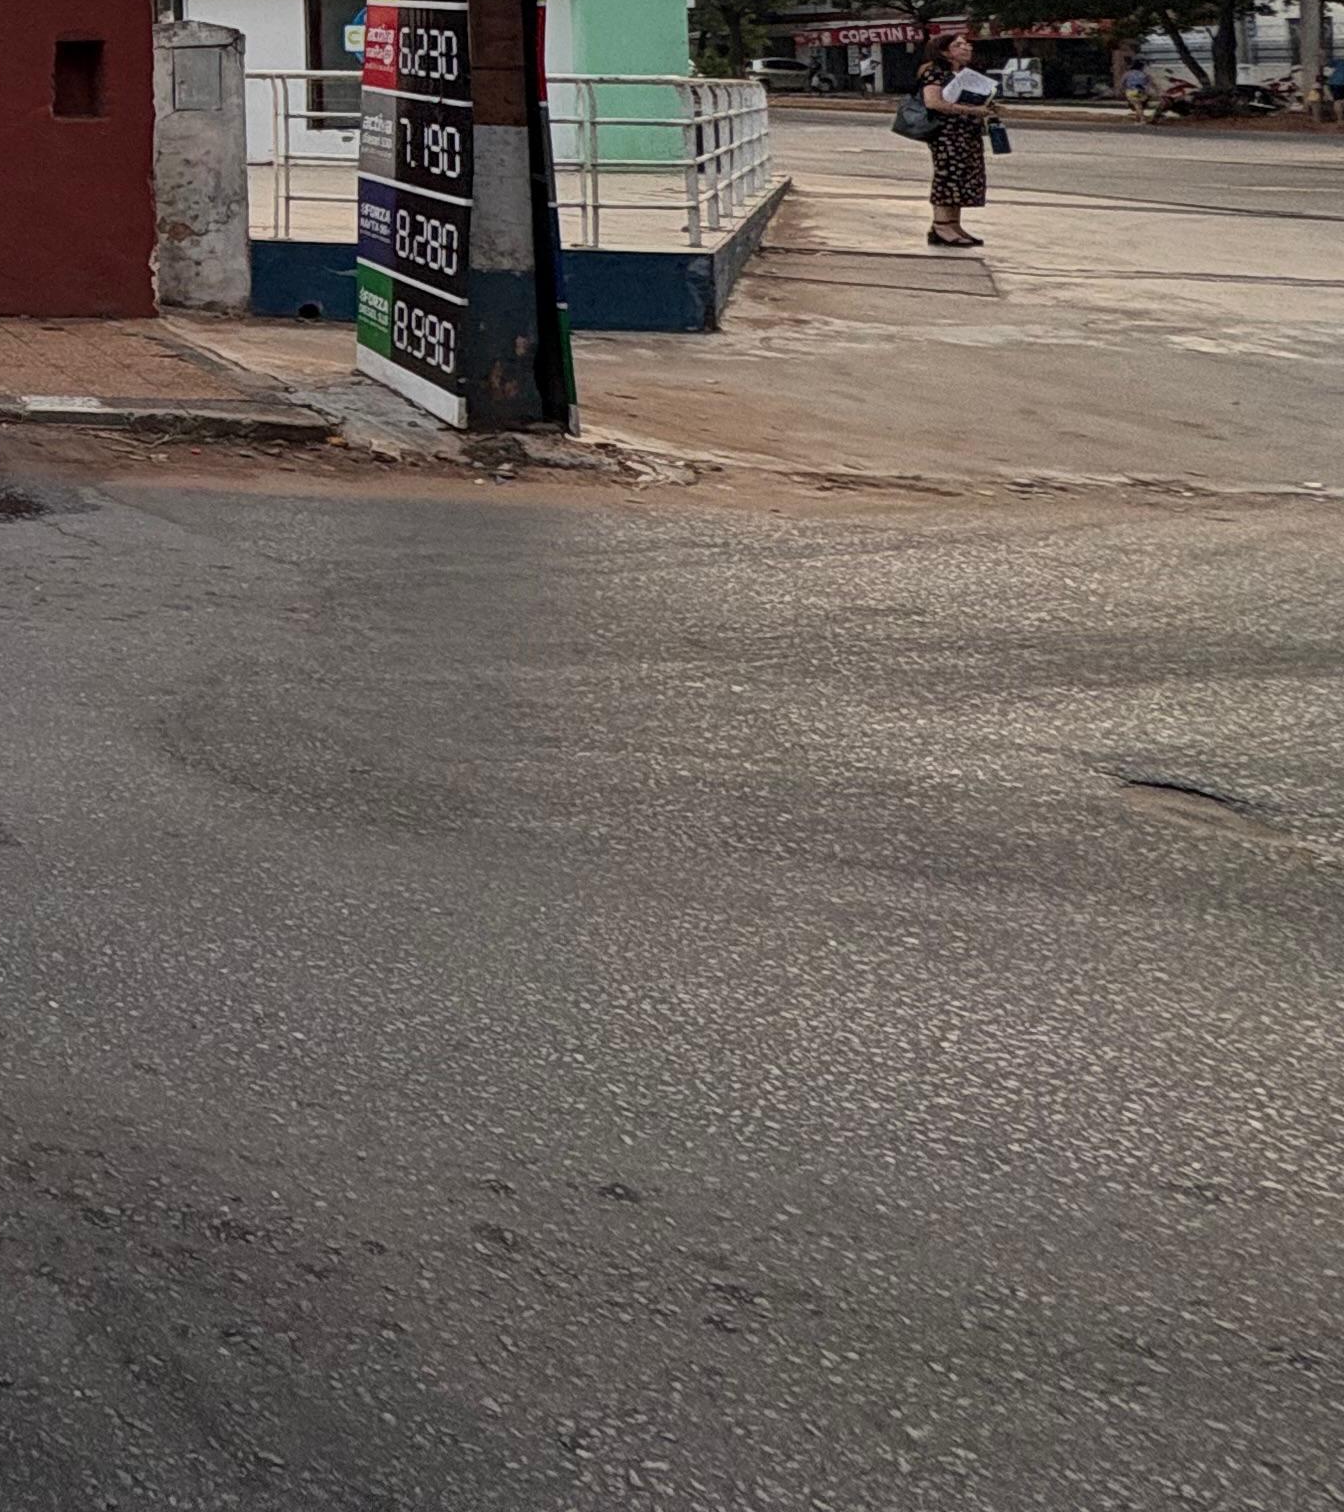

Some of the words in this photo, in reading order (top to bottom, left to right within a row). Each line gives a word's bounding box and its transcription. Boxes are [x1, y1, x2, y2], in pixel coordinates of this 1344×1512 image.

[399, 26, 458, 80] 6.230
[838, 26, 906, 44] COPETIN
[399, 117, 460, 178] 7.190
[396, 209, 458, 276] 8.280
[394, 300, 455, 374] 8.990
